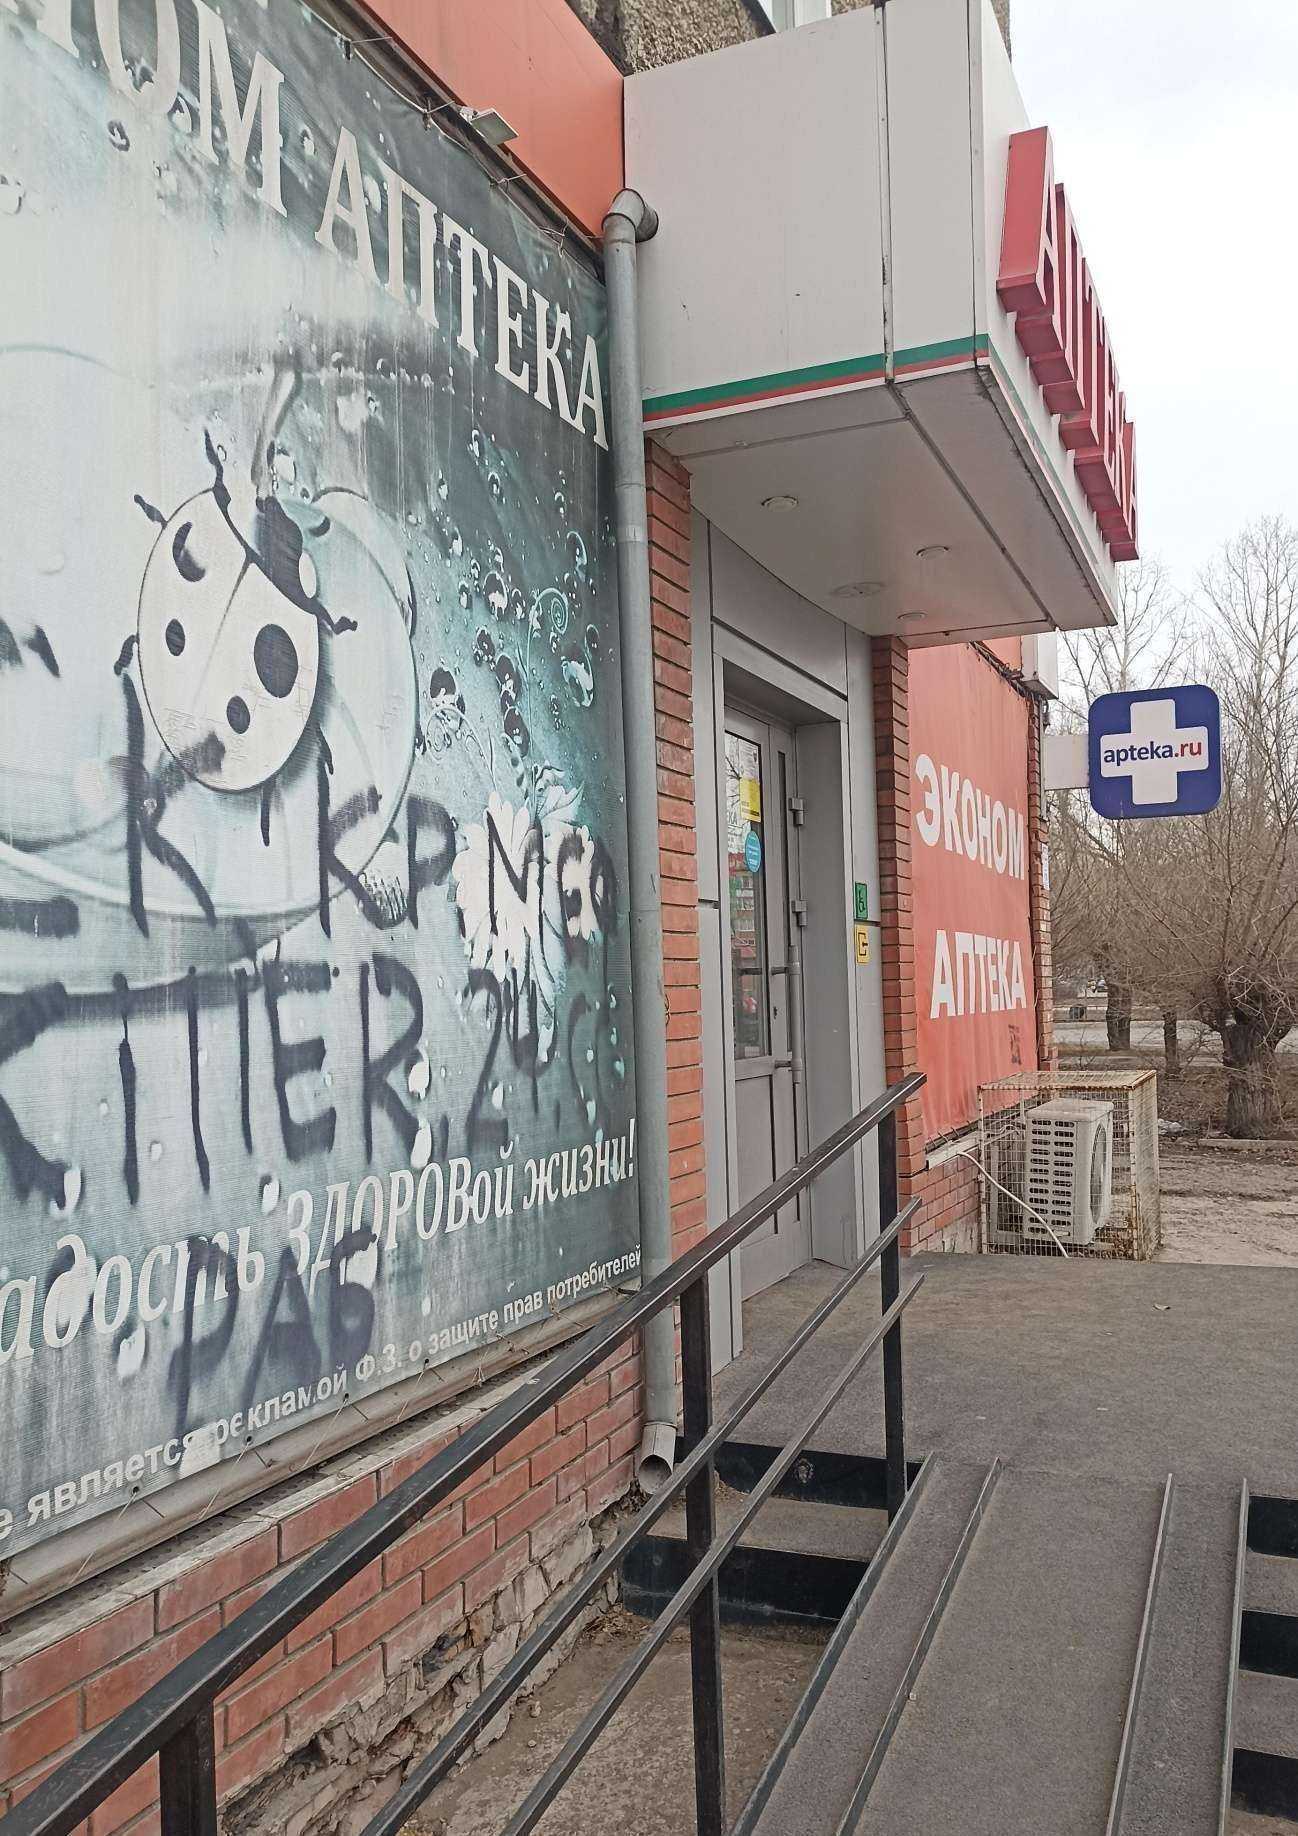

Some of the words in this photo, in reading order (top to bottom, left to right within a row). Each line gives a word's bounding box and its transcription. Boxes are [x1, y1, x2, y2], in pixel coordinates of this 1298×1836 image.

[0, 0, 287, 217] ОМ
[315, 126, 608, 450] АПТЕКА
[1103, 741, 1202, 766] apteka.ru
[915, 753, 1025, 880] ЭКОНОМ
[930, 929, 1027, 1019] АПТЕКА
[524, 1118, 636, 1209] жизни!
[409, 1340, 422, 1362] о
[428, 1309, 499, 1355] защите
[503, 1291, 543, 1325] прав
[547, 1244, 642, 1304] потребителей
